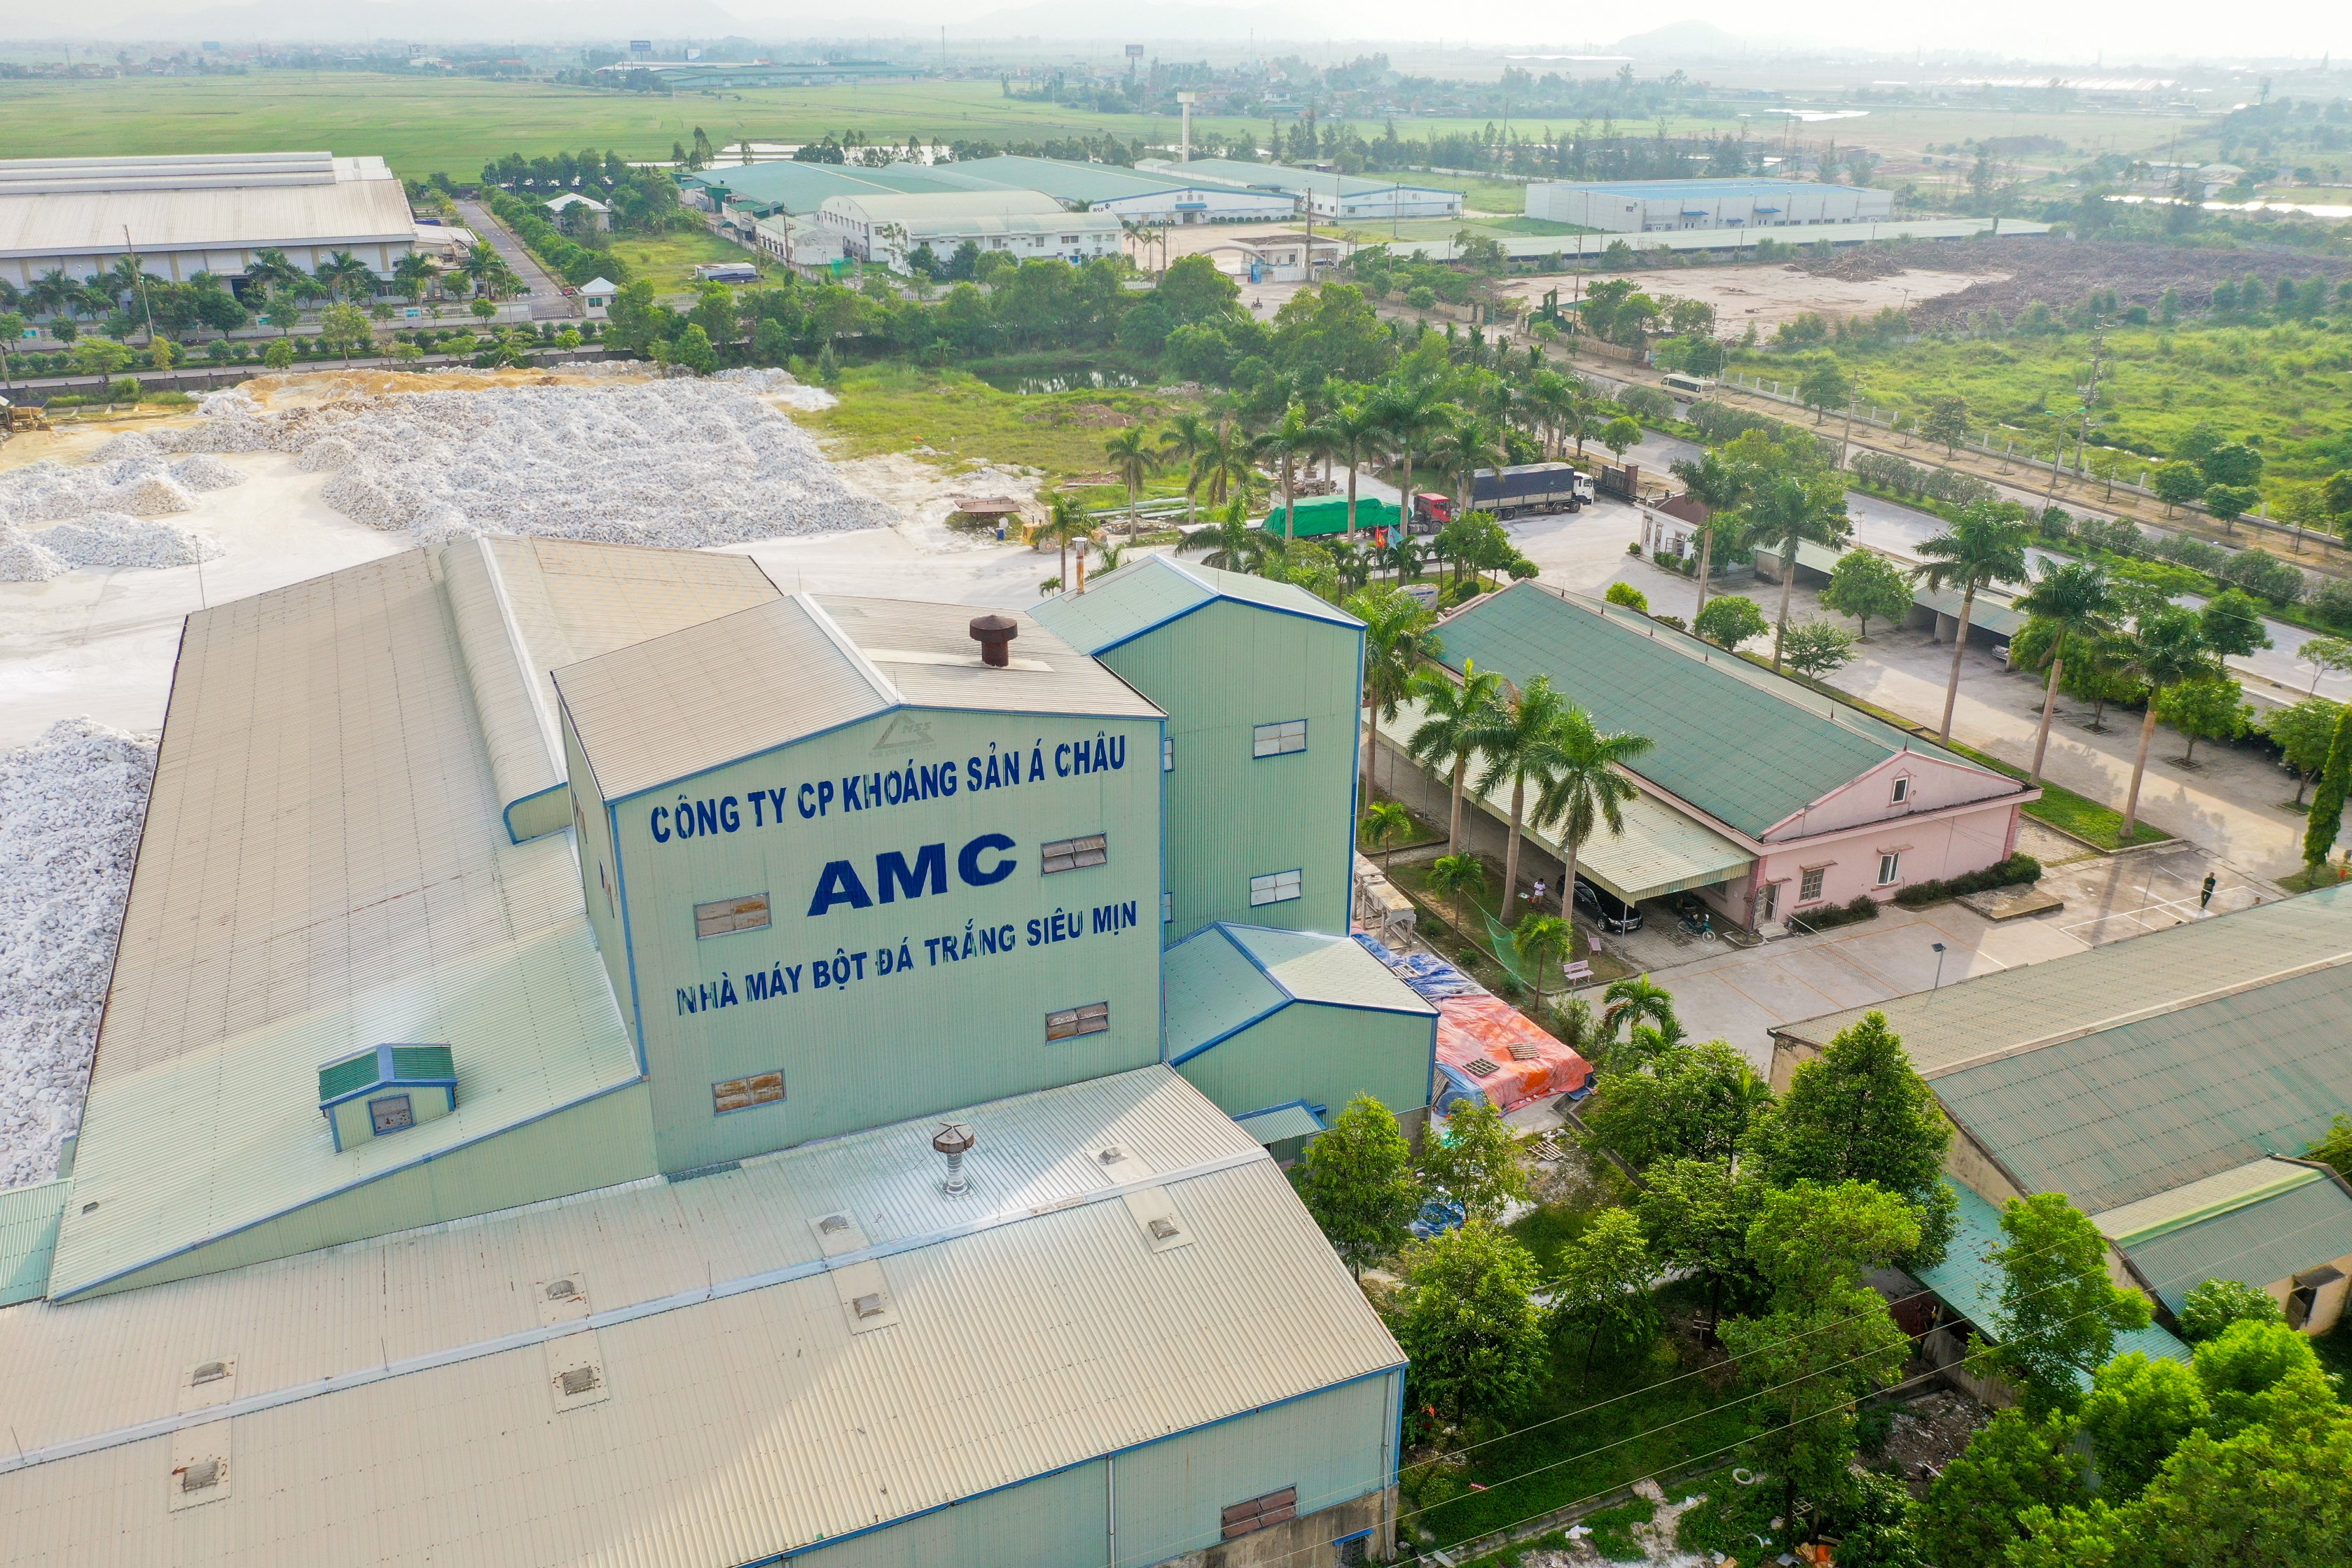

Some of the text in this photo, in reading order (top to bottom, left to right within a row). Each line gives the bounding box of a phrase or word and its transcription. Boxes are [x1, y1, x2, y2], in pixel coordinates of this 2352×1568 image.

[651, 730, 1125, 843] CÔNG TY CP KHOÁNG SẢN Á CHÂU
[807, 833, 1017, 917] AMC
[677, 901, 1136, 1016] NHÀ MÁY BỘT ĐÁ TRẮNG SIÊU MỊN
